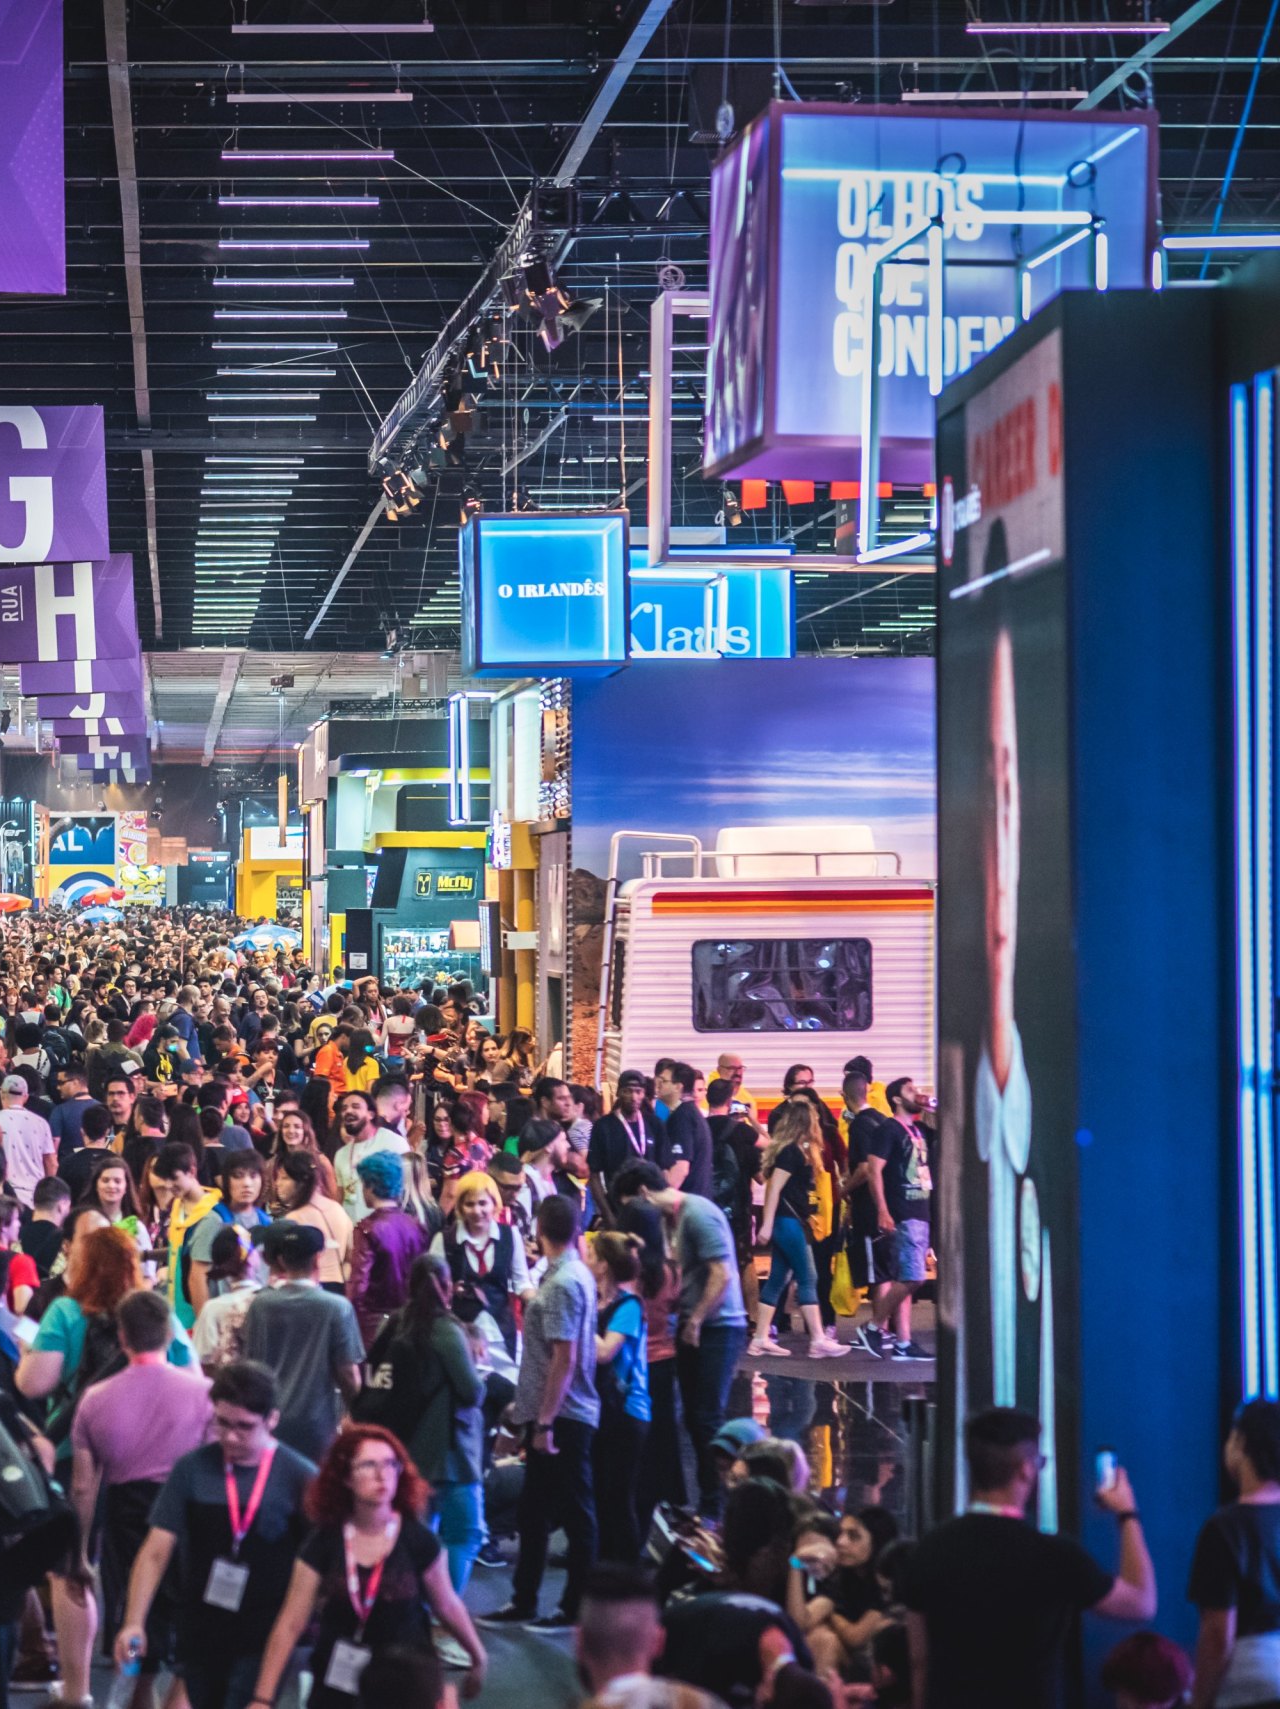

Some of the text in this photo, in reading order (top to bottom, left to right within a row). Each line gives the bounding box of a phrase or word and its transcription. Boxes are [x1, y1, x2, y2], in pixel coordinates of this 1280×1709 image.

[837, 177, 985, 241] OLHOS
[835, 242, 926, 312] QUE
[2, 585, 19, 623] RUA
[34, 562, 96, 661] H
[498, 578, 606, 599] O IRLANDÊS
